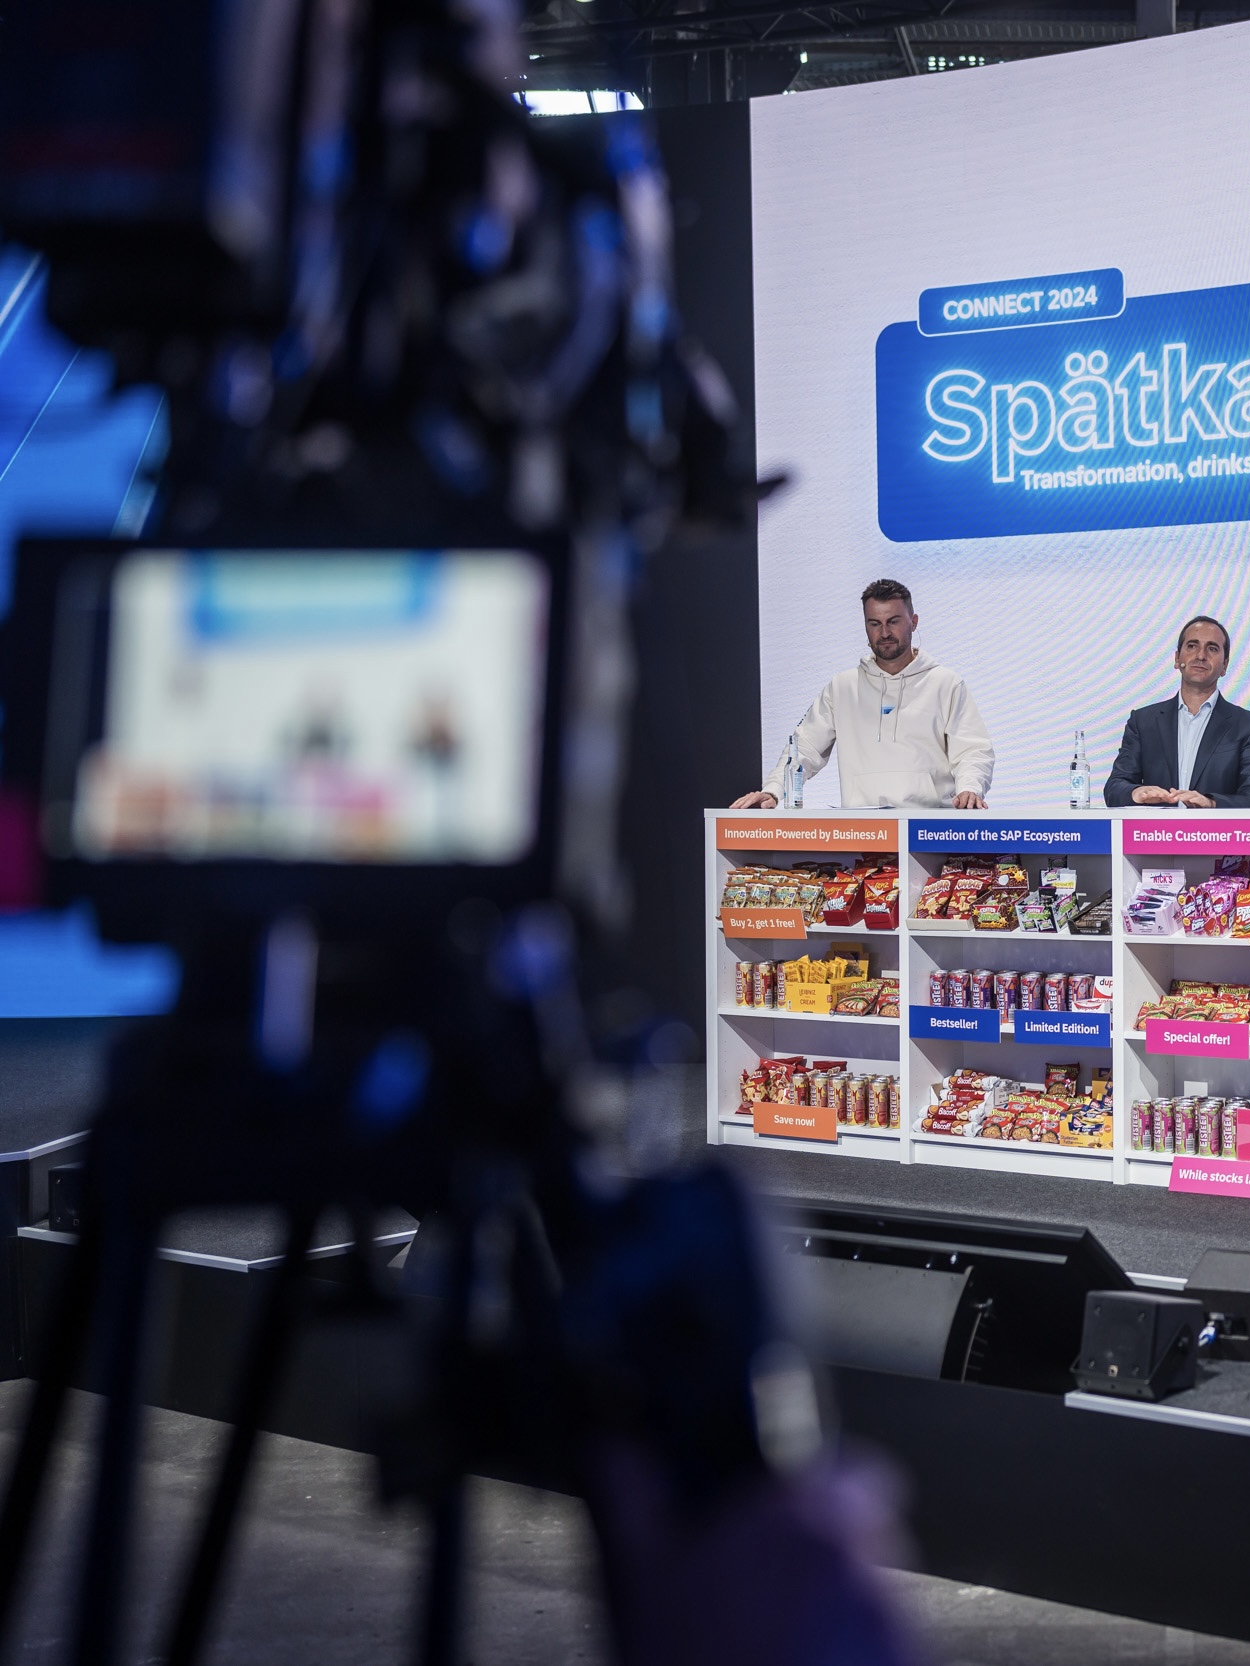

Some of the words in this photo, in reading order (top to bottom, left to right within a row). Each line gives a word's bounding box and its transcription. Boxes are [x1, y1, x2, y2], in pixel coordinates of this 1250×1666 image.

[942, 291, 1045, 322] CONNECT
[1047, 285, 1099, 312] 2024
[1020, 458, 1184, 491] Transformation,
[724, 828, 774, 839] Innovation
[775, 828, 817, 840] Powered
[819, 828, 831, 842] by
[833, 829, 876, 840] Business
[877, 829, 887, 840] AI
[917, 829, 966, 841] Elevation
[967, 829, 979, 841] of
[980, 829, 998, 841] the
[1000, 830, 1022, 841] SAP
[1023, 830, 1081, 844] Ecosystem
[1133, 830, 1173, 842] Enable
[1174, 830, 1232, 842] Customer
[730, 918, 745, 929] Buy
[747, 918, 755, 929] 2,
[755, 919, 769, 929] get
[770, 918, 775, 928] 1
[776, 918, 796, 928] free!
[1099, 978, 1113, 989] dup
[800, 998, 816, 1006] CREAM
[930, 1017, 978, 1030] Bestseller!
[1025, 1021, 1060, 1033] Limited
[1062, 1023, 1100, 1035] Edition!
[1163, 1031, 1201, 1045] Special
[1202, 1033, 1231, 1046] offer!
[773, 1114, 794, 1125] Save
[795, 1117, 815, 1127] now!
[1179, 1168, 1208, 1181] While
[1209, 1172, 1244, 1184] stocks
